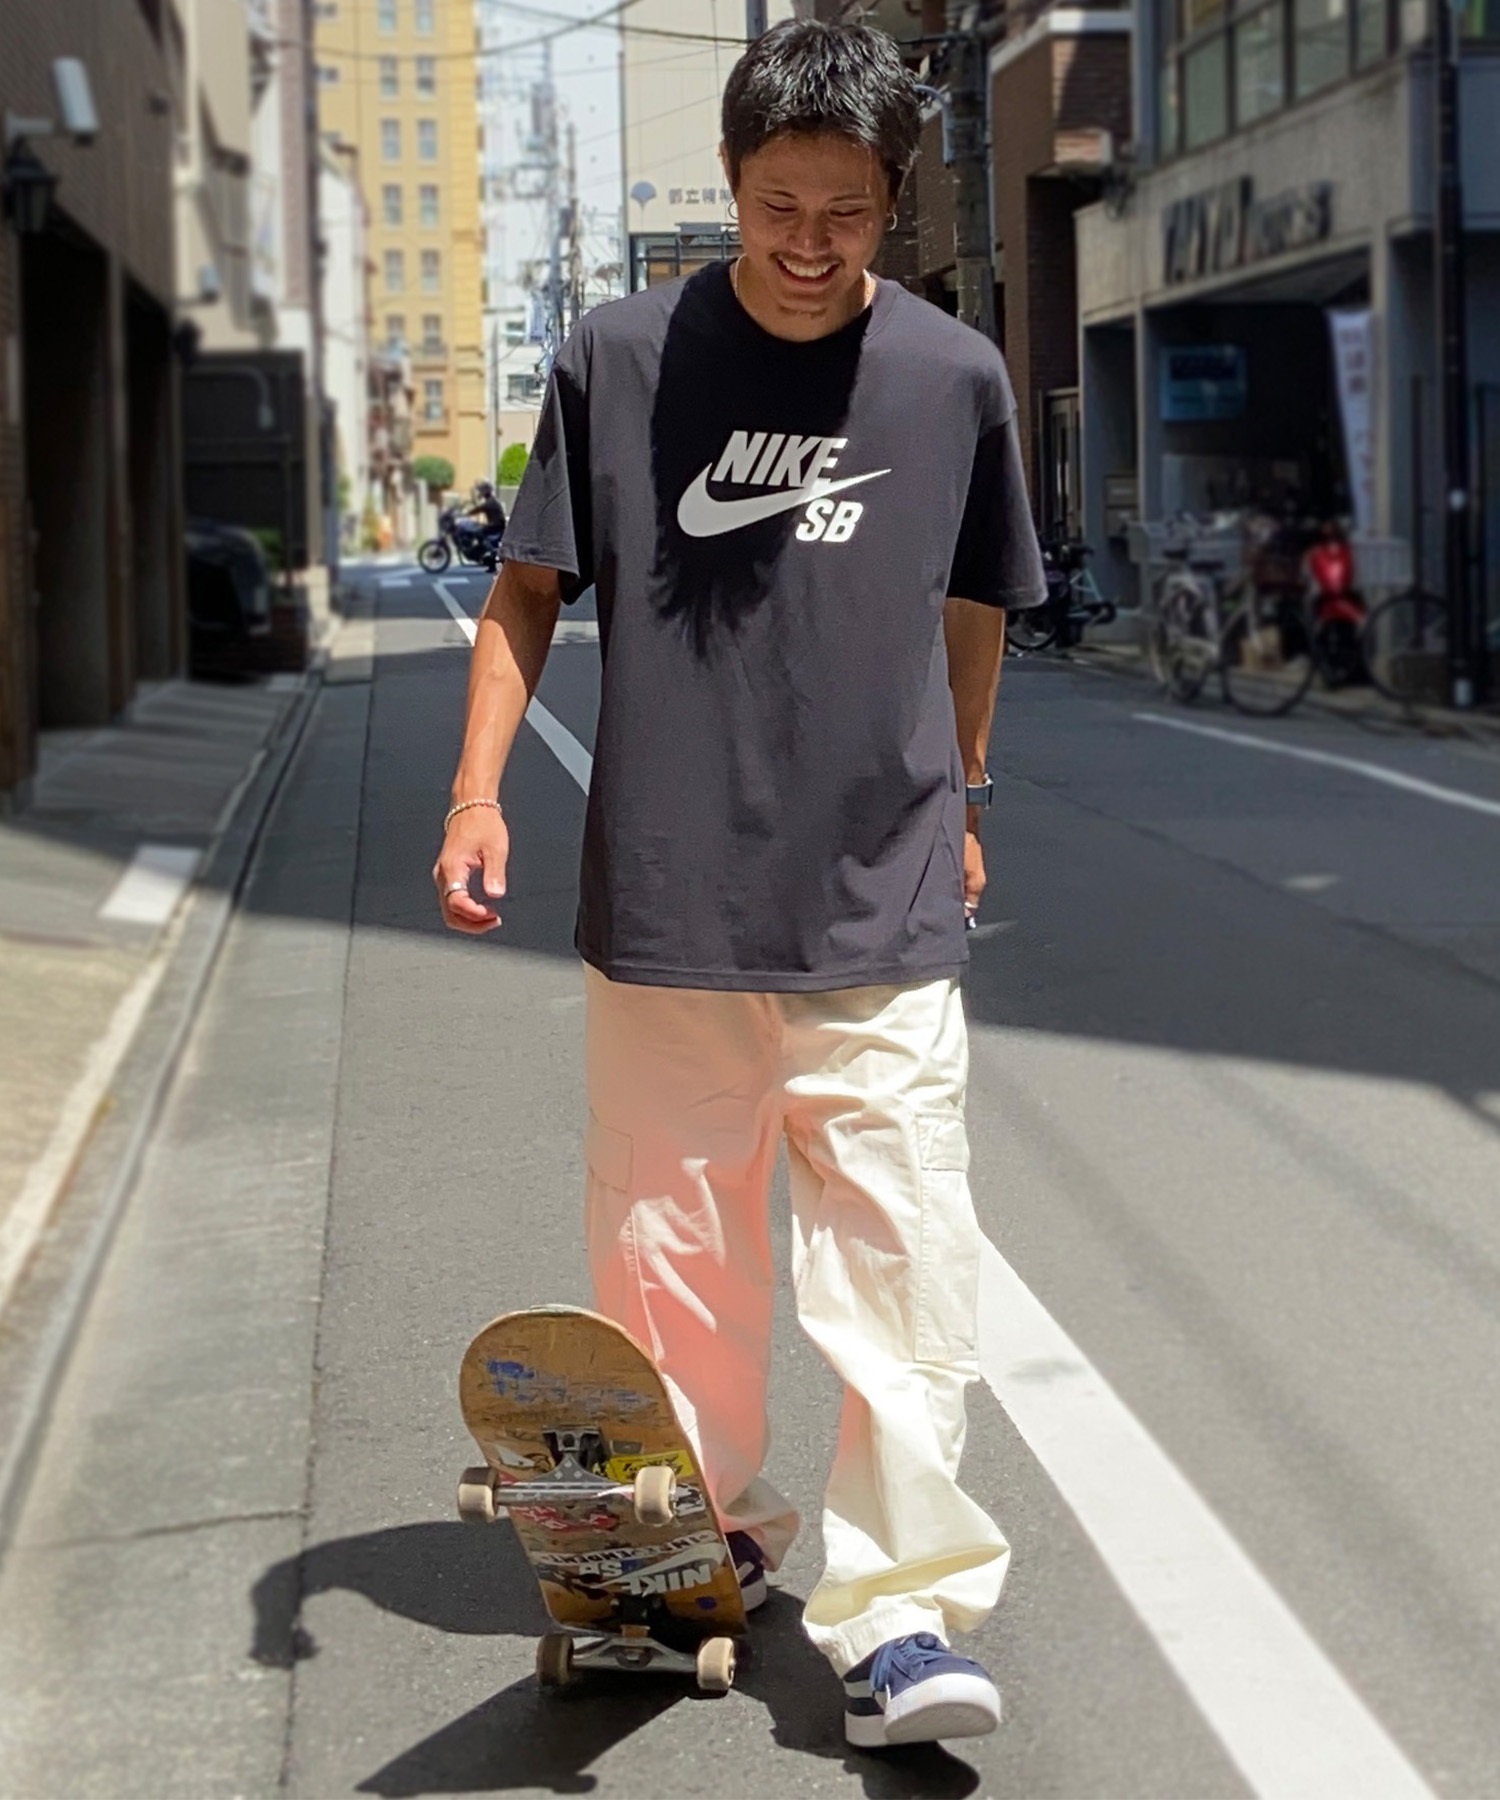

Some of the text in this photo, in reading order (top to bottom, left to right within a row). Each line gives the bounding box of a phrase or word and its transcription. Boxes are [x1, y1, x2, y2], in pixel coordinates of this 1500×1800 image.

[711, 430, 848, 488] NIKE
[795, 498, 864, 543] SB
[548, 1535, 702, 1564] INENDENT
[622, 1563, 712, 1597] NIKE
